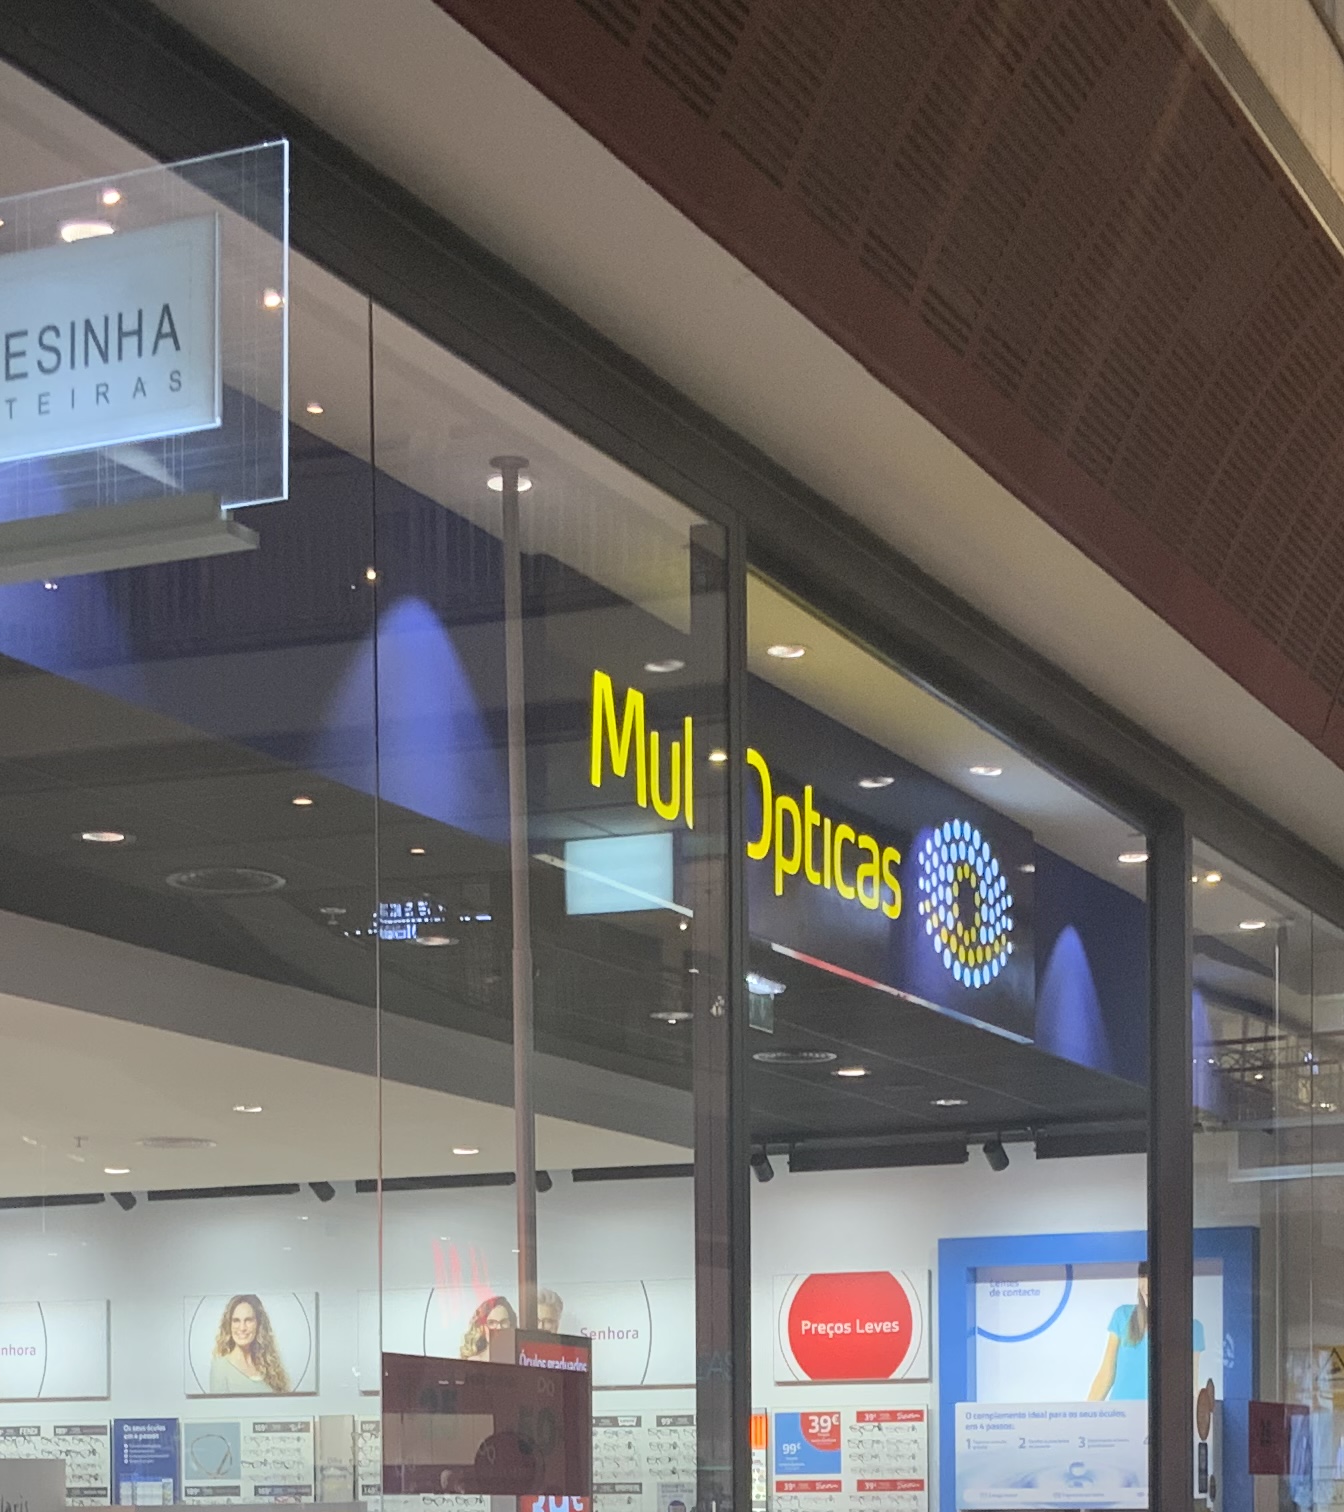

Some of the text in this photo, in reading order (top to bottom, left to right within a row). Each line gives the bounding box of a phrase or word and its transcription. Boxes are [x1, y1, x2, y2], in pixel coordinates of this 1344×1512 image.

[580, 1326, 639, 1340] Senhora
[801, 1318, 900, 1339] Preços Leves
[808, 1413, 840, 1434] 39€
[965, 1438, 972, 1450] 1
[1018, 1437, 1026, 1449] 2
[1078, 1436, 1086, 1449] 3
